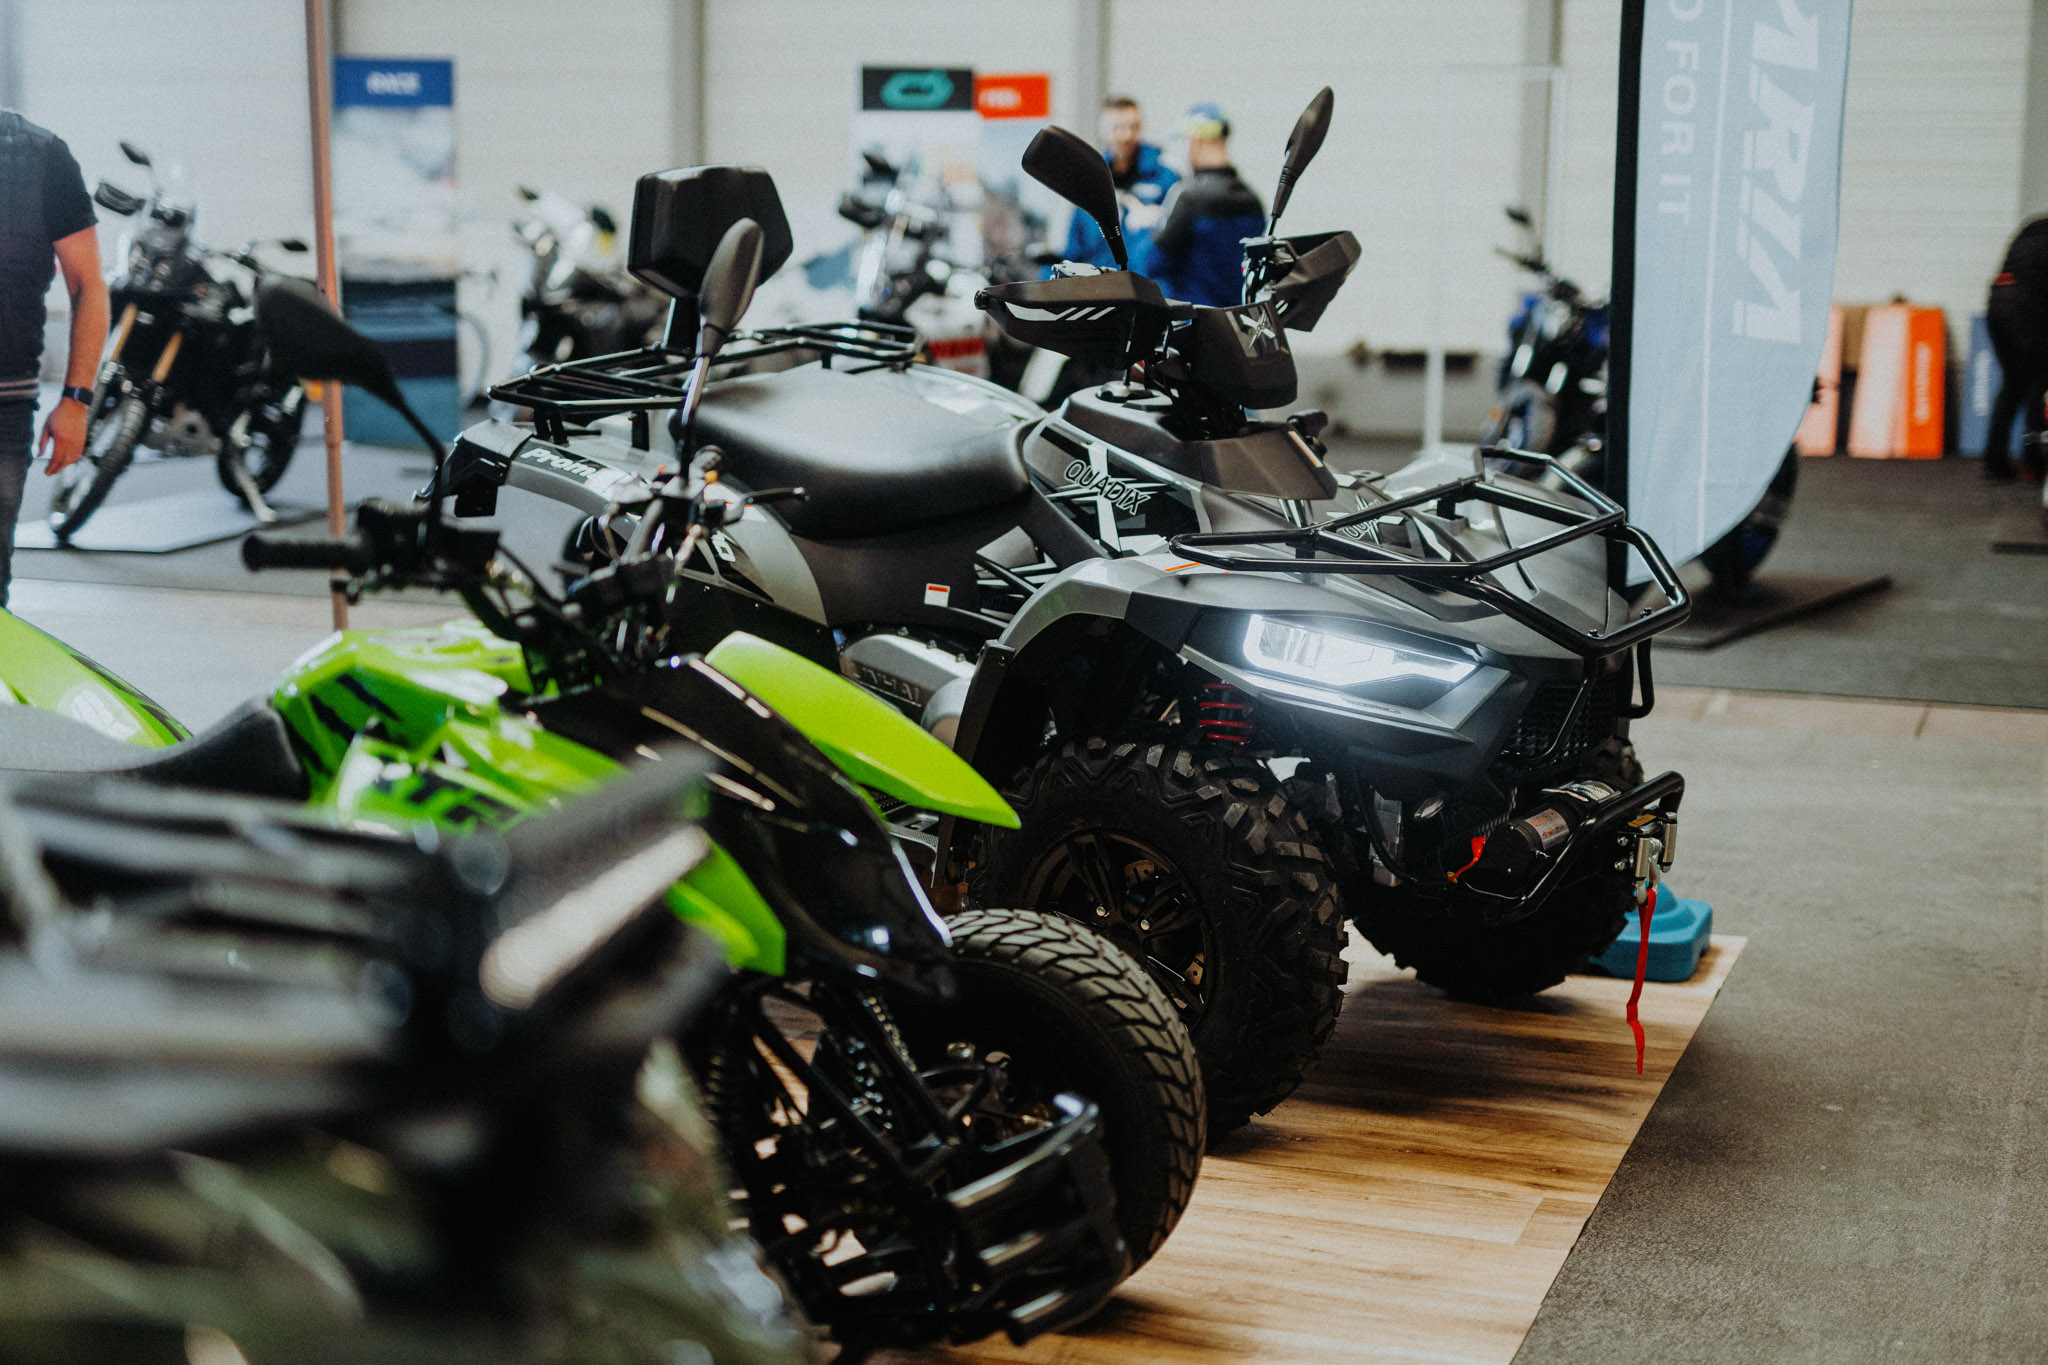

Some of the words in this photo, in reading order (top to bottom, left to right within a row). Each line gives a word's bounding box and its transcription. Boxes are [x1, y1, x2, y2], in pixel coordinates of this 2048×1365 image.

[1663, 40, 1701, 155] FOR
[1658, 173, 1692, 225] IT
[1064, 459, 1152, 516] QUADIX
